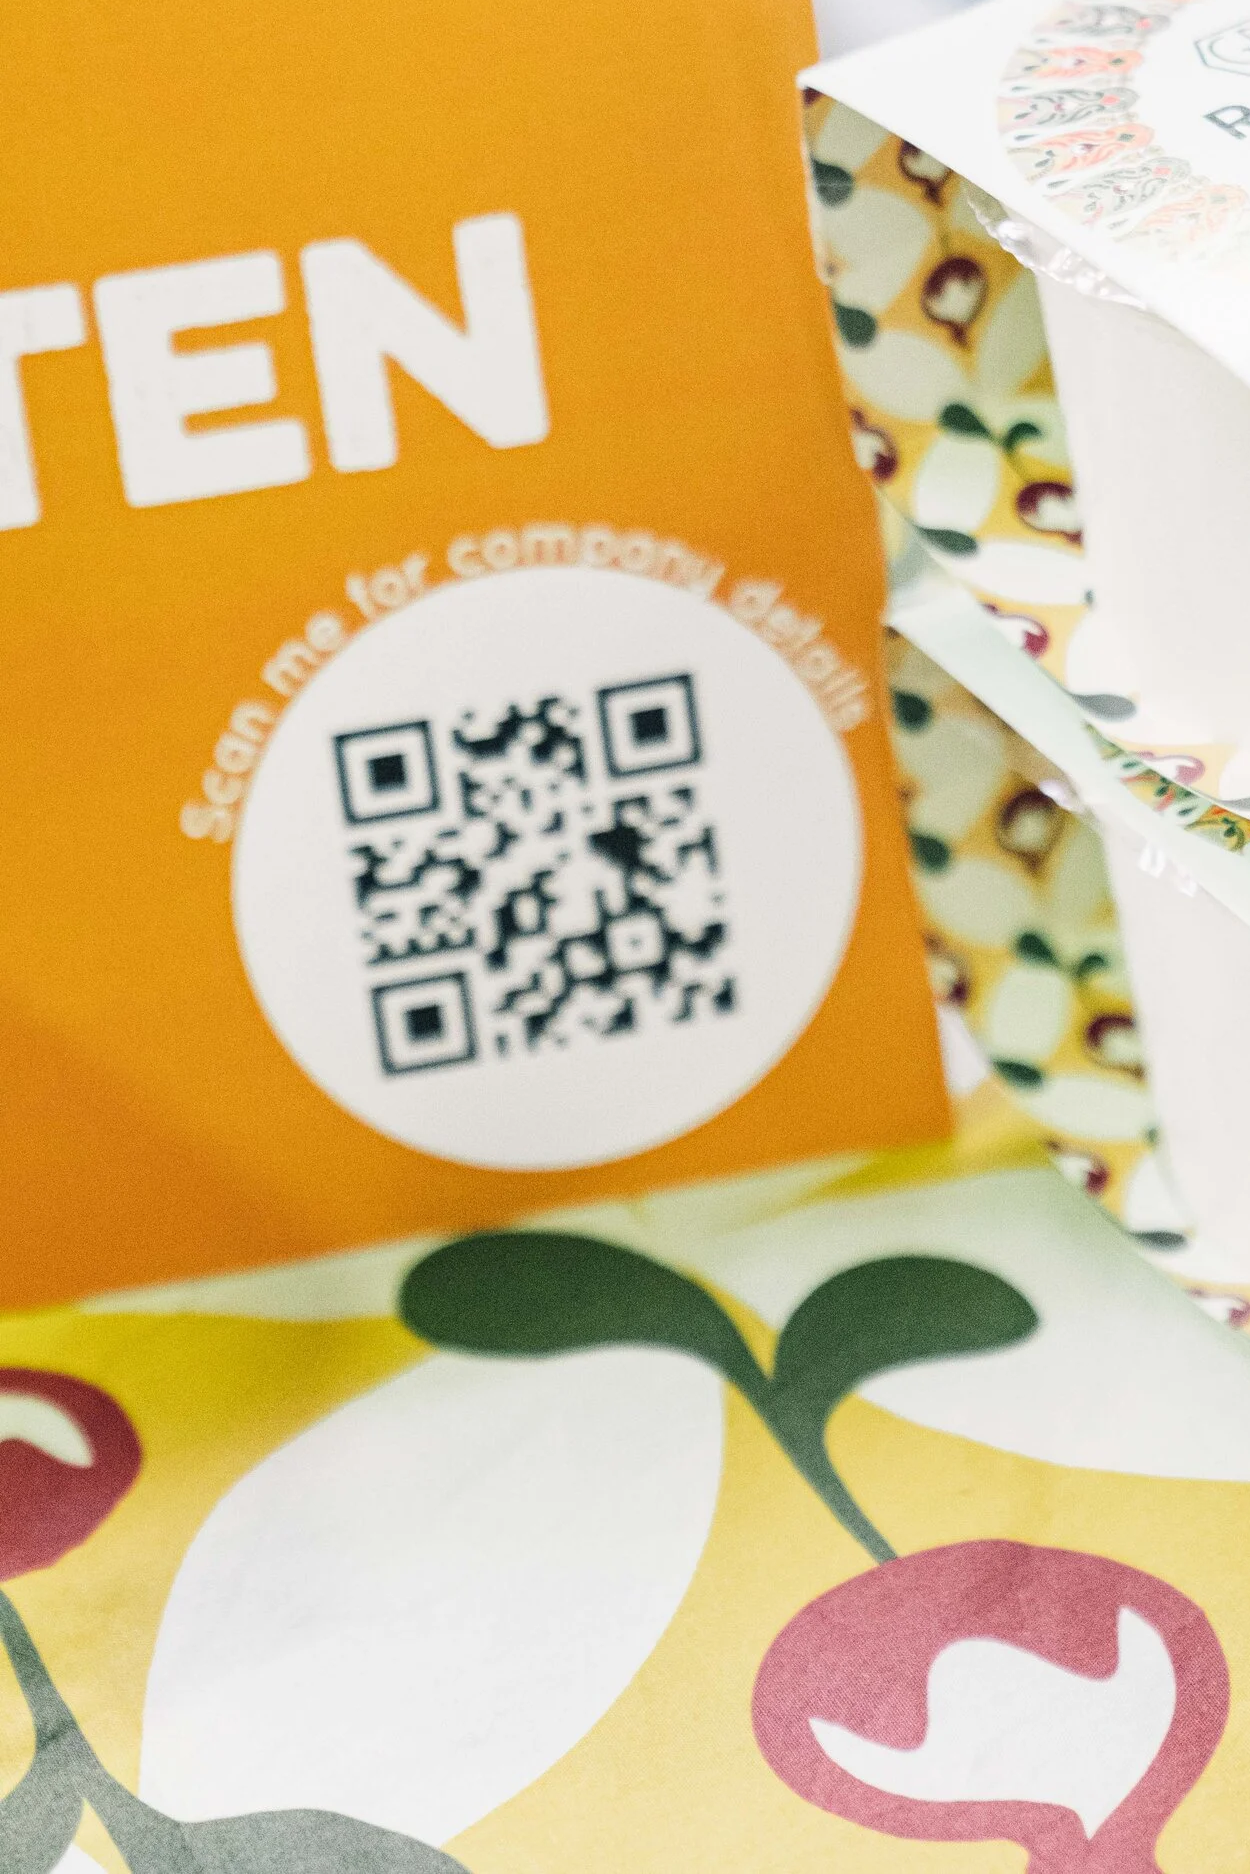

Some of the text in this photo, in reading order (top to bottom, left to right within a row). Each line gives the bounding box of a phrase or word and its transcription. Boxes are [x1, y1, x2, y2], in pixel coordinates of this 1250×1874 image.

[180, 521, 869, 844] Scan me for company details
